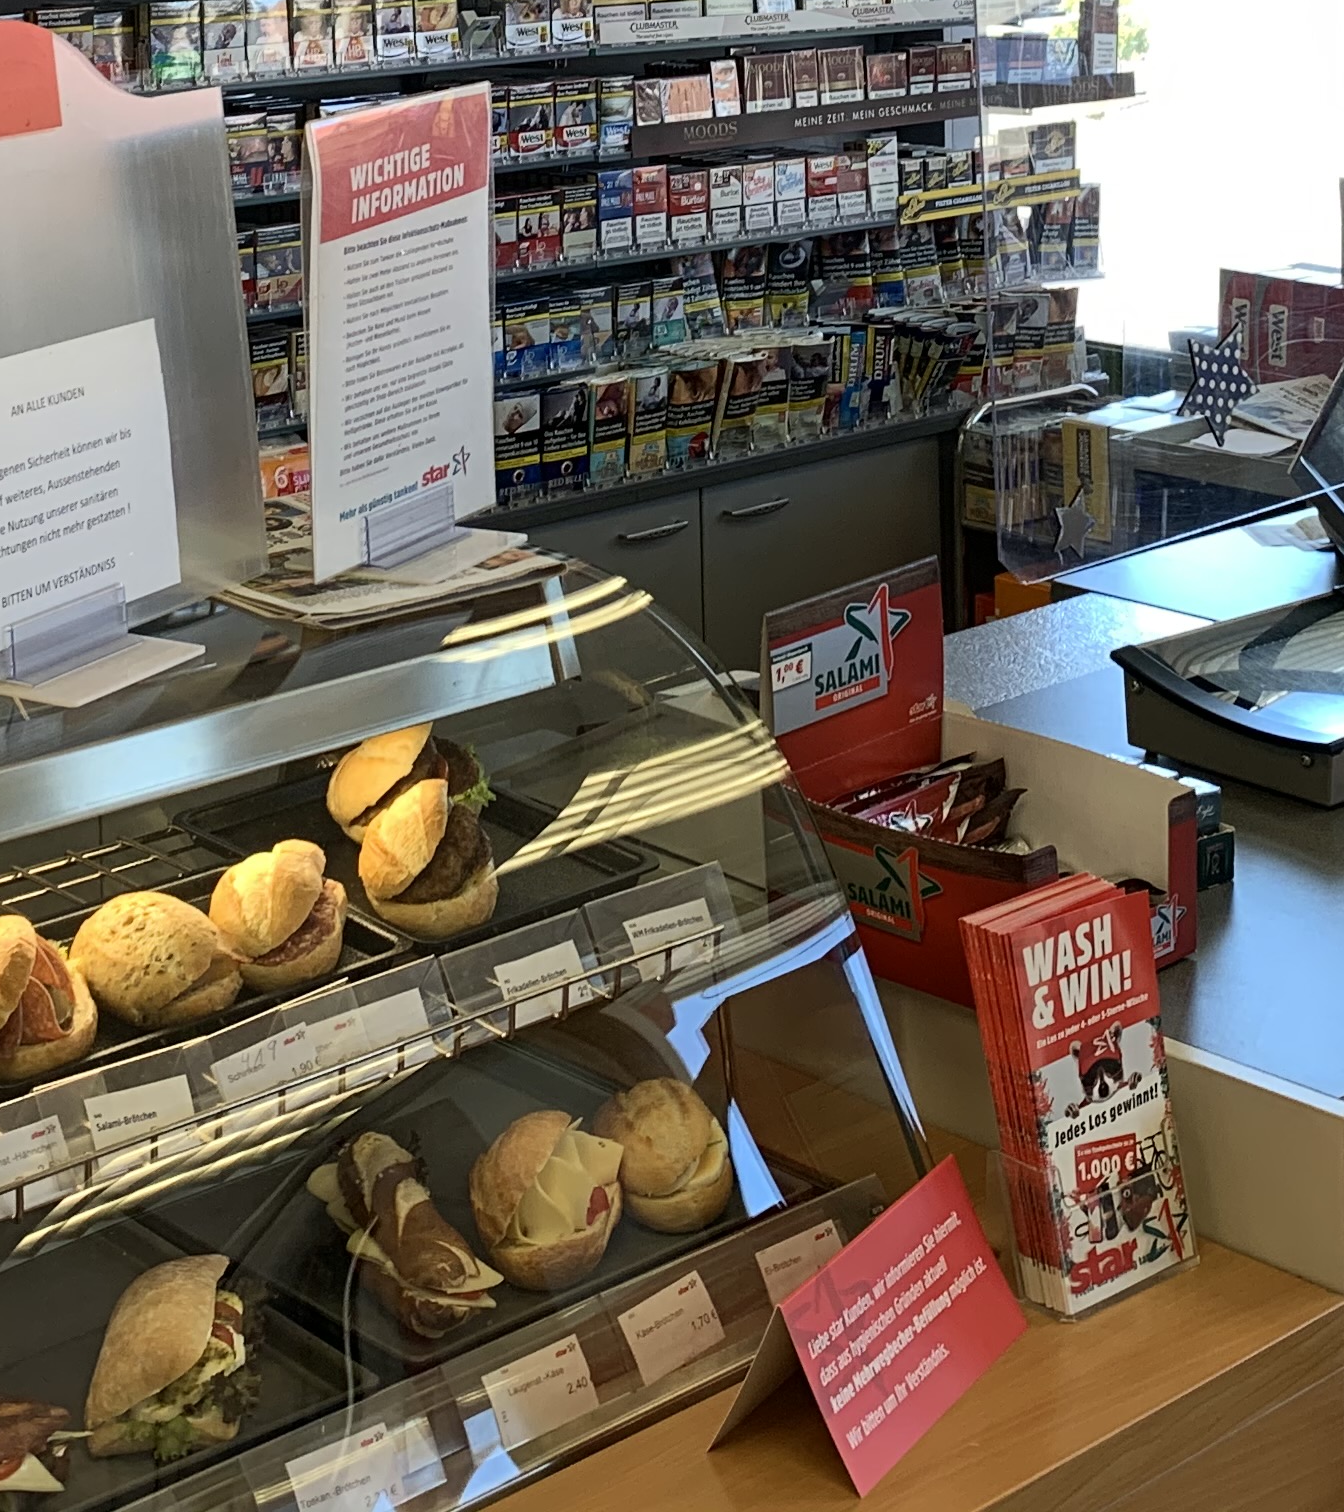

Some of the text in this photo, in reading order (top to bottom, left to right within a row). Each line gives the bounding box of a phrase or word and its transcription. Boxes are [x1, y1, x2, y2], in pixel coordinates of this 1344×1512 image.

[630, 21, 679, 34] CLUBMASTER
[684, 121, 738, 141] MOODS
[794, 116, 823, 128] MEINE
[852, 109, 876, 121] MEIN
[878, 102, 936, 119] GESCHMACK.
[350, 143, 431, 191] WICHTIGE
[351, 162, 465, 224] INFORMATION
[873, 335, 885, 381] DRUM
[11, 387, 85, 417] AN ALLE KUNDEN
[27, 447, 71, 469] Sicherheit
[72, 436, 104, 457] können
[105, 431, 118, 445] wir
[119, 428, 131, 440] bis
[5, 485, 46, 505] weiteres,
[47, 459, 121, 491] Aussenstehenden
[340, 463, 450, 522] Mehr als günstig tanken! star
[8, 512, 44, 535] Nutzung
[46, 500, 79, 520] unserer
[80, 487, 119, 510] sanitären
[39, 527, 61, 544] nicht
[62, 521, 85, 537] mehr
[86, 506, 126, 530] gestatten
[2, 588, 33, 609] BITTEN
[35, 581, 51, 596] UM
[52, 557, 116, 590] VERSTÄNDNISS
[814, 653, 880, 697] SALAMI
[832, 684, 863, 702] ORIGINAL
[1022, 913, 1112, 988] WASH
[1032, 949, 1133, 1030] & WIN!
[96, 1110, 157, 1133] Salami-Brötchen
[1055, 1121, 1086, 1148] Jedes
[1089, 1111, 1106, 1131] Los
[1110, 1083, 1158, 1123] gewinnt!
[1077, 1158, 1121, 1182] 1.000
[1069, 1237, 1138, 1294] star
[808, 1328, 830, 1359] Liebe
[828, 1316, 845, 1340] star
[843, 1292, 875, 1326] Kunden,
[872, 1280, 887, 1300] wir
[883, 1242, 926, 1289] informieren
[922, 1232, 937, 1253] Sie
[818, 1255, 948, 1387] dass aus hygienischen Gründen aktuell
[830, 1256, 987, 1414] keine Mehrwegbecher-Befüllung möglich ist.
[846, 1342, 950, 1449] Wir bitten um Ihr Verständnis.
